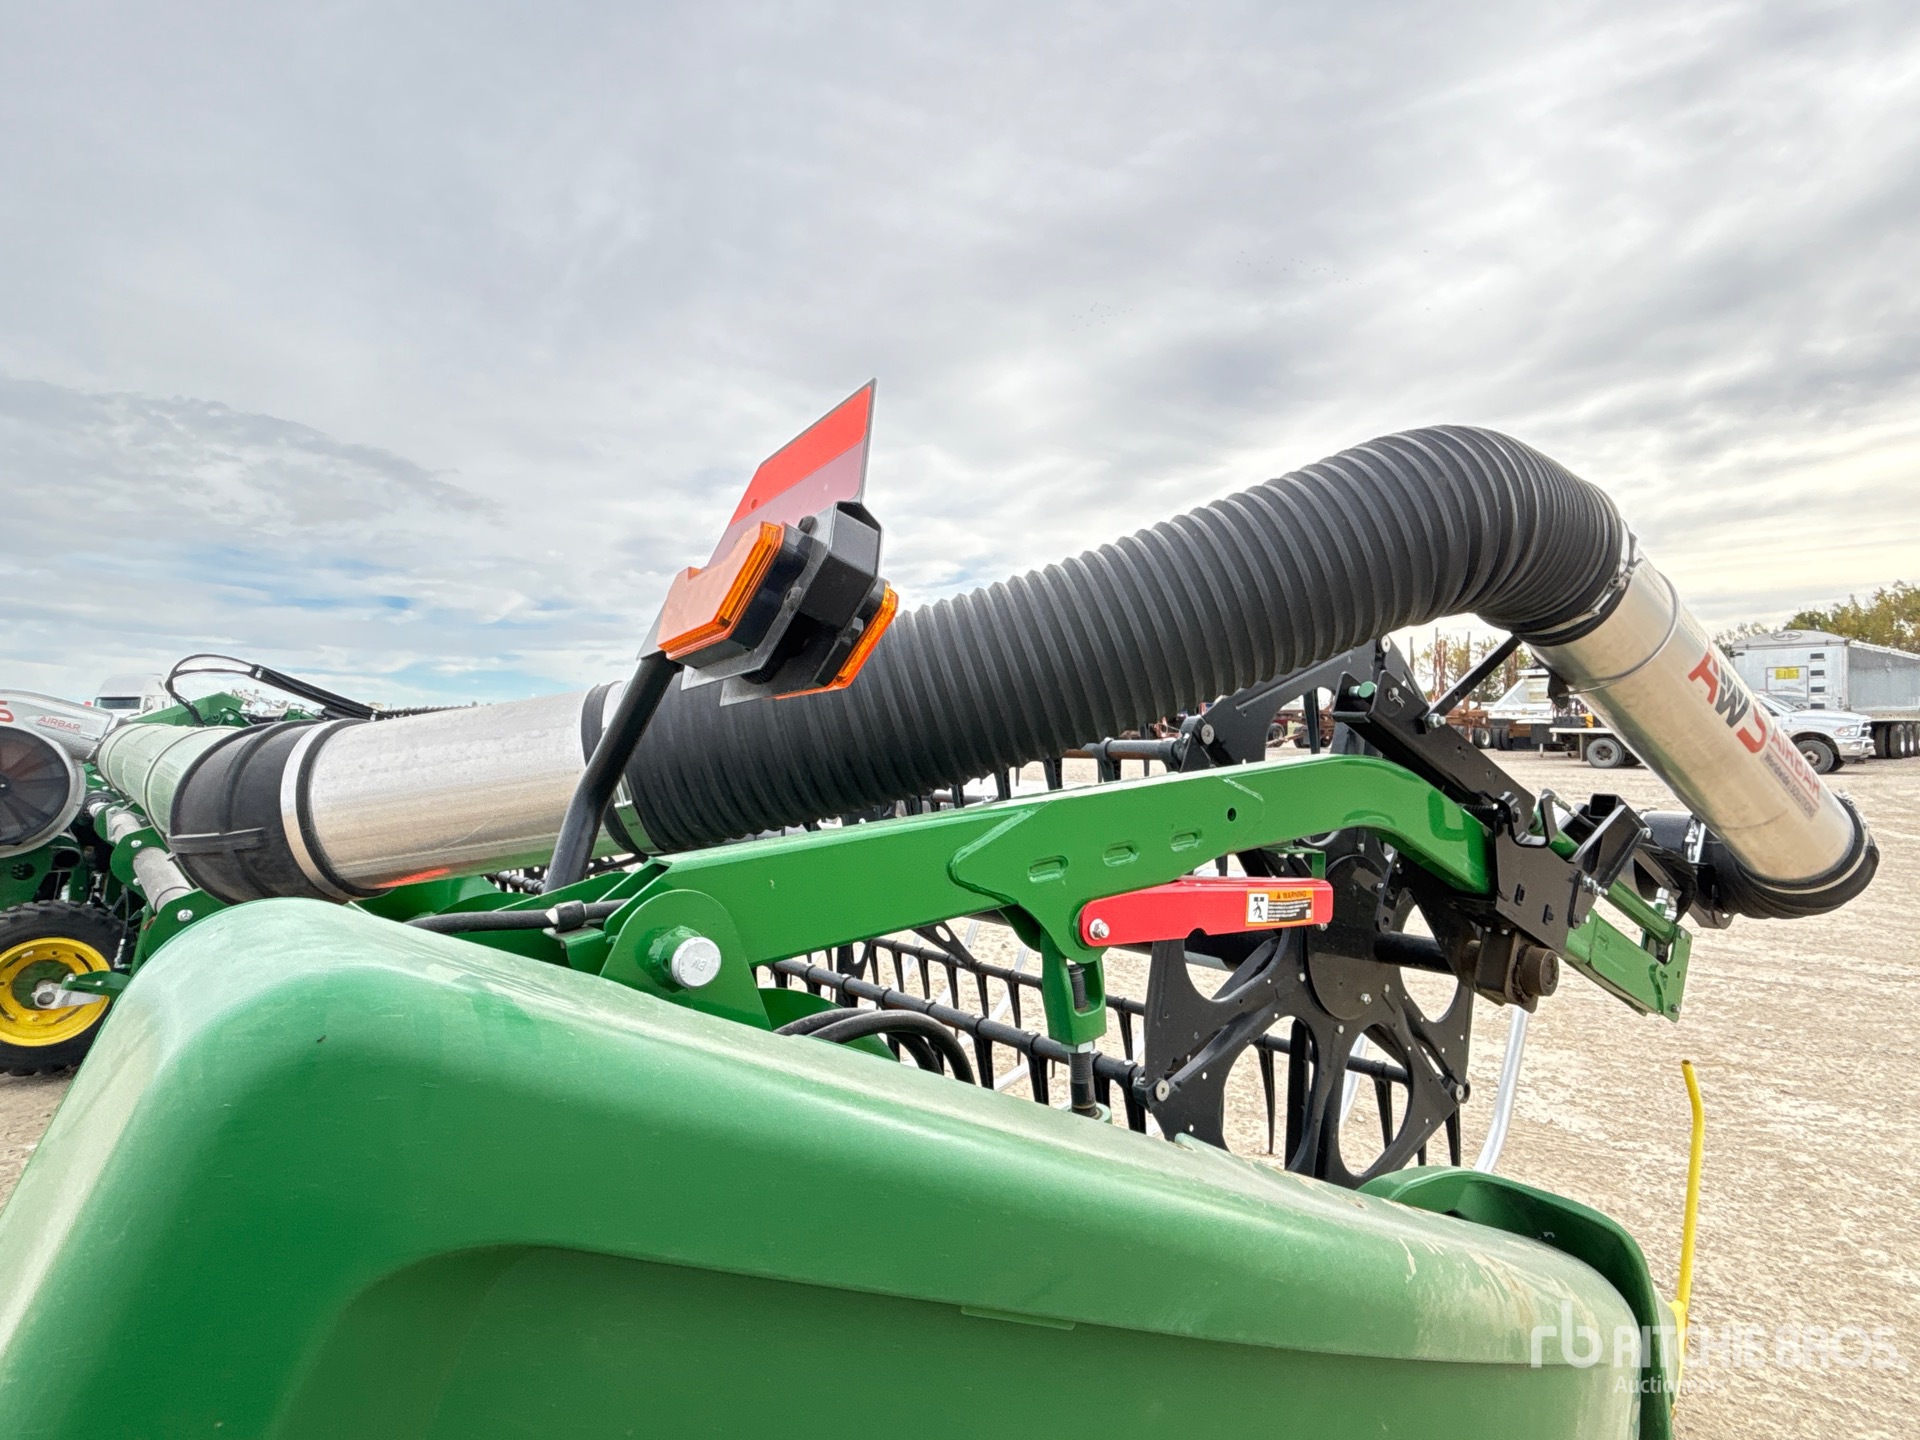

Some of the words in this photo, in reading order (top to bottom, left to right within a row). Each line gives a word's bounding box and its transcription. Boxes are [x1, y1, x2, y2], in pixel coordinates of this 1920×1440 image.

[37, 715, 81, 732] AIRBAR
[1763, 751, 1791, 787] Worldwide
[1788, 783, 1817, 818] SOLUTIONS
[1282, 890, 1307, 899] WARNING
